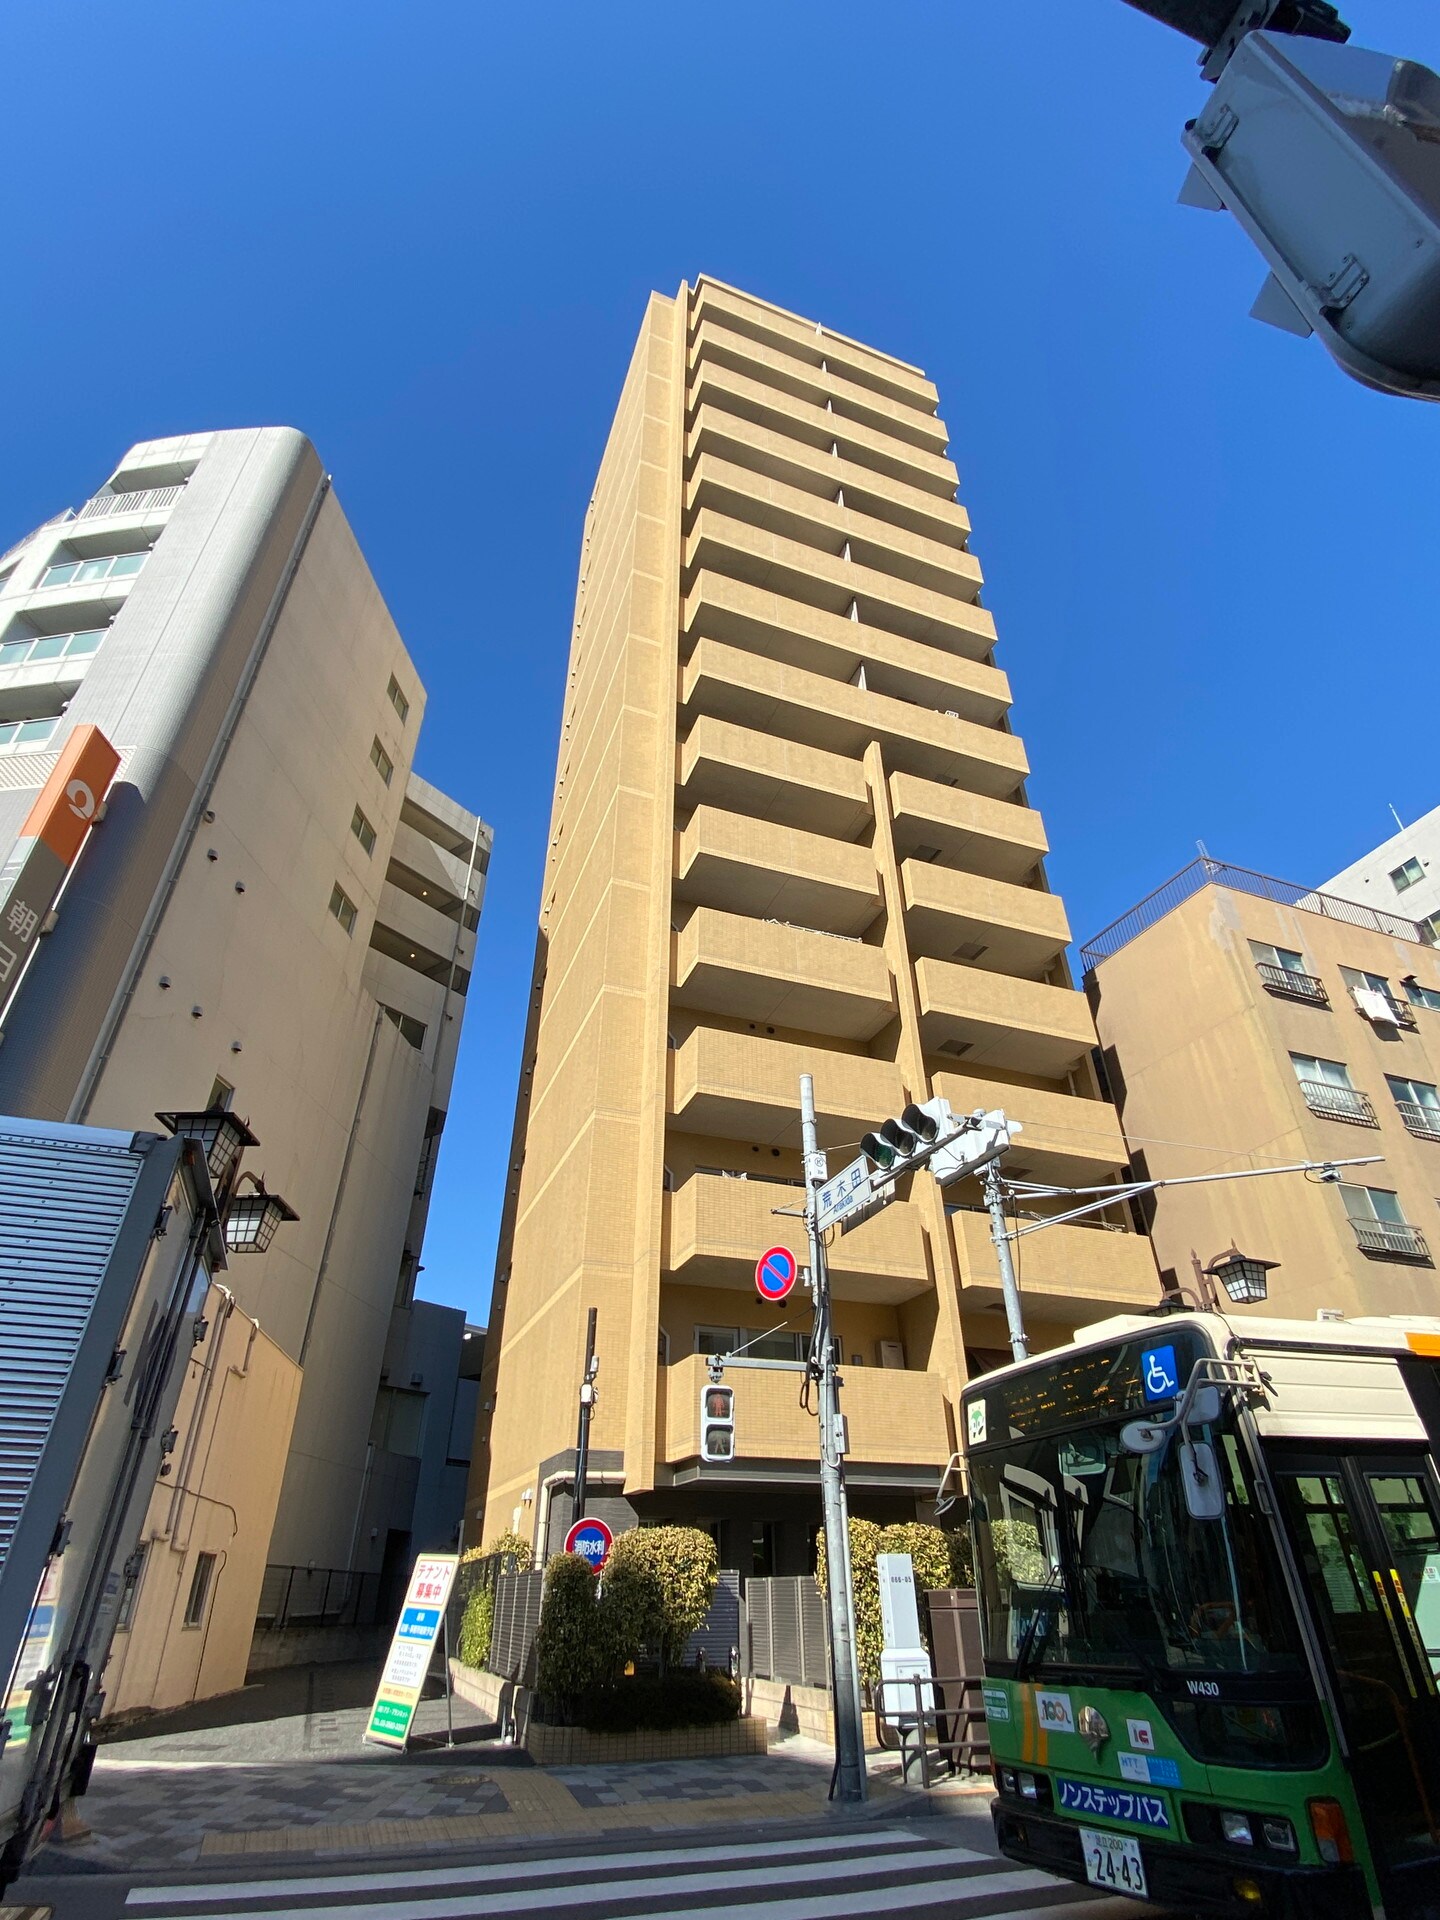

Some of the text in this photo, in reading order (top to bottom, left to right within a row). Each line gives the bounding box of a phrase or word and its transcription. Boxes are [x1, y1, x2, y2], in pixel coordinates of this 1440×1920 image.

[821, 1167, 862, 1211] 荒木田
[833, 1195, 854, 1215] Arakida
[574, 1539, 605, 1555] 消防水利
[417, 1564, 450, 1580] テナント
[415, 1582, 443, 1600] 募集中
[1185, 1679, 1220, 1696] W430
[1060, 1782, 1169, 1826] ノンステップバス
